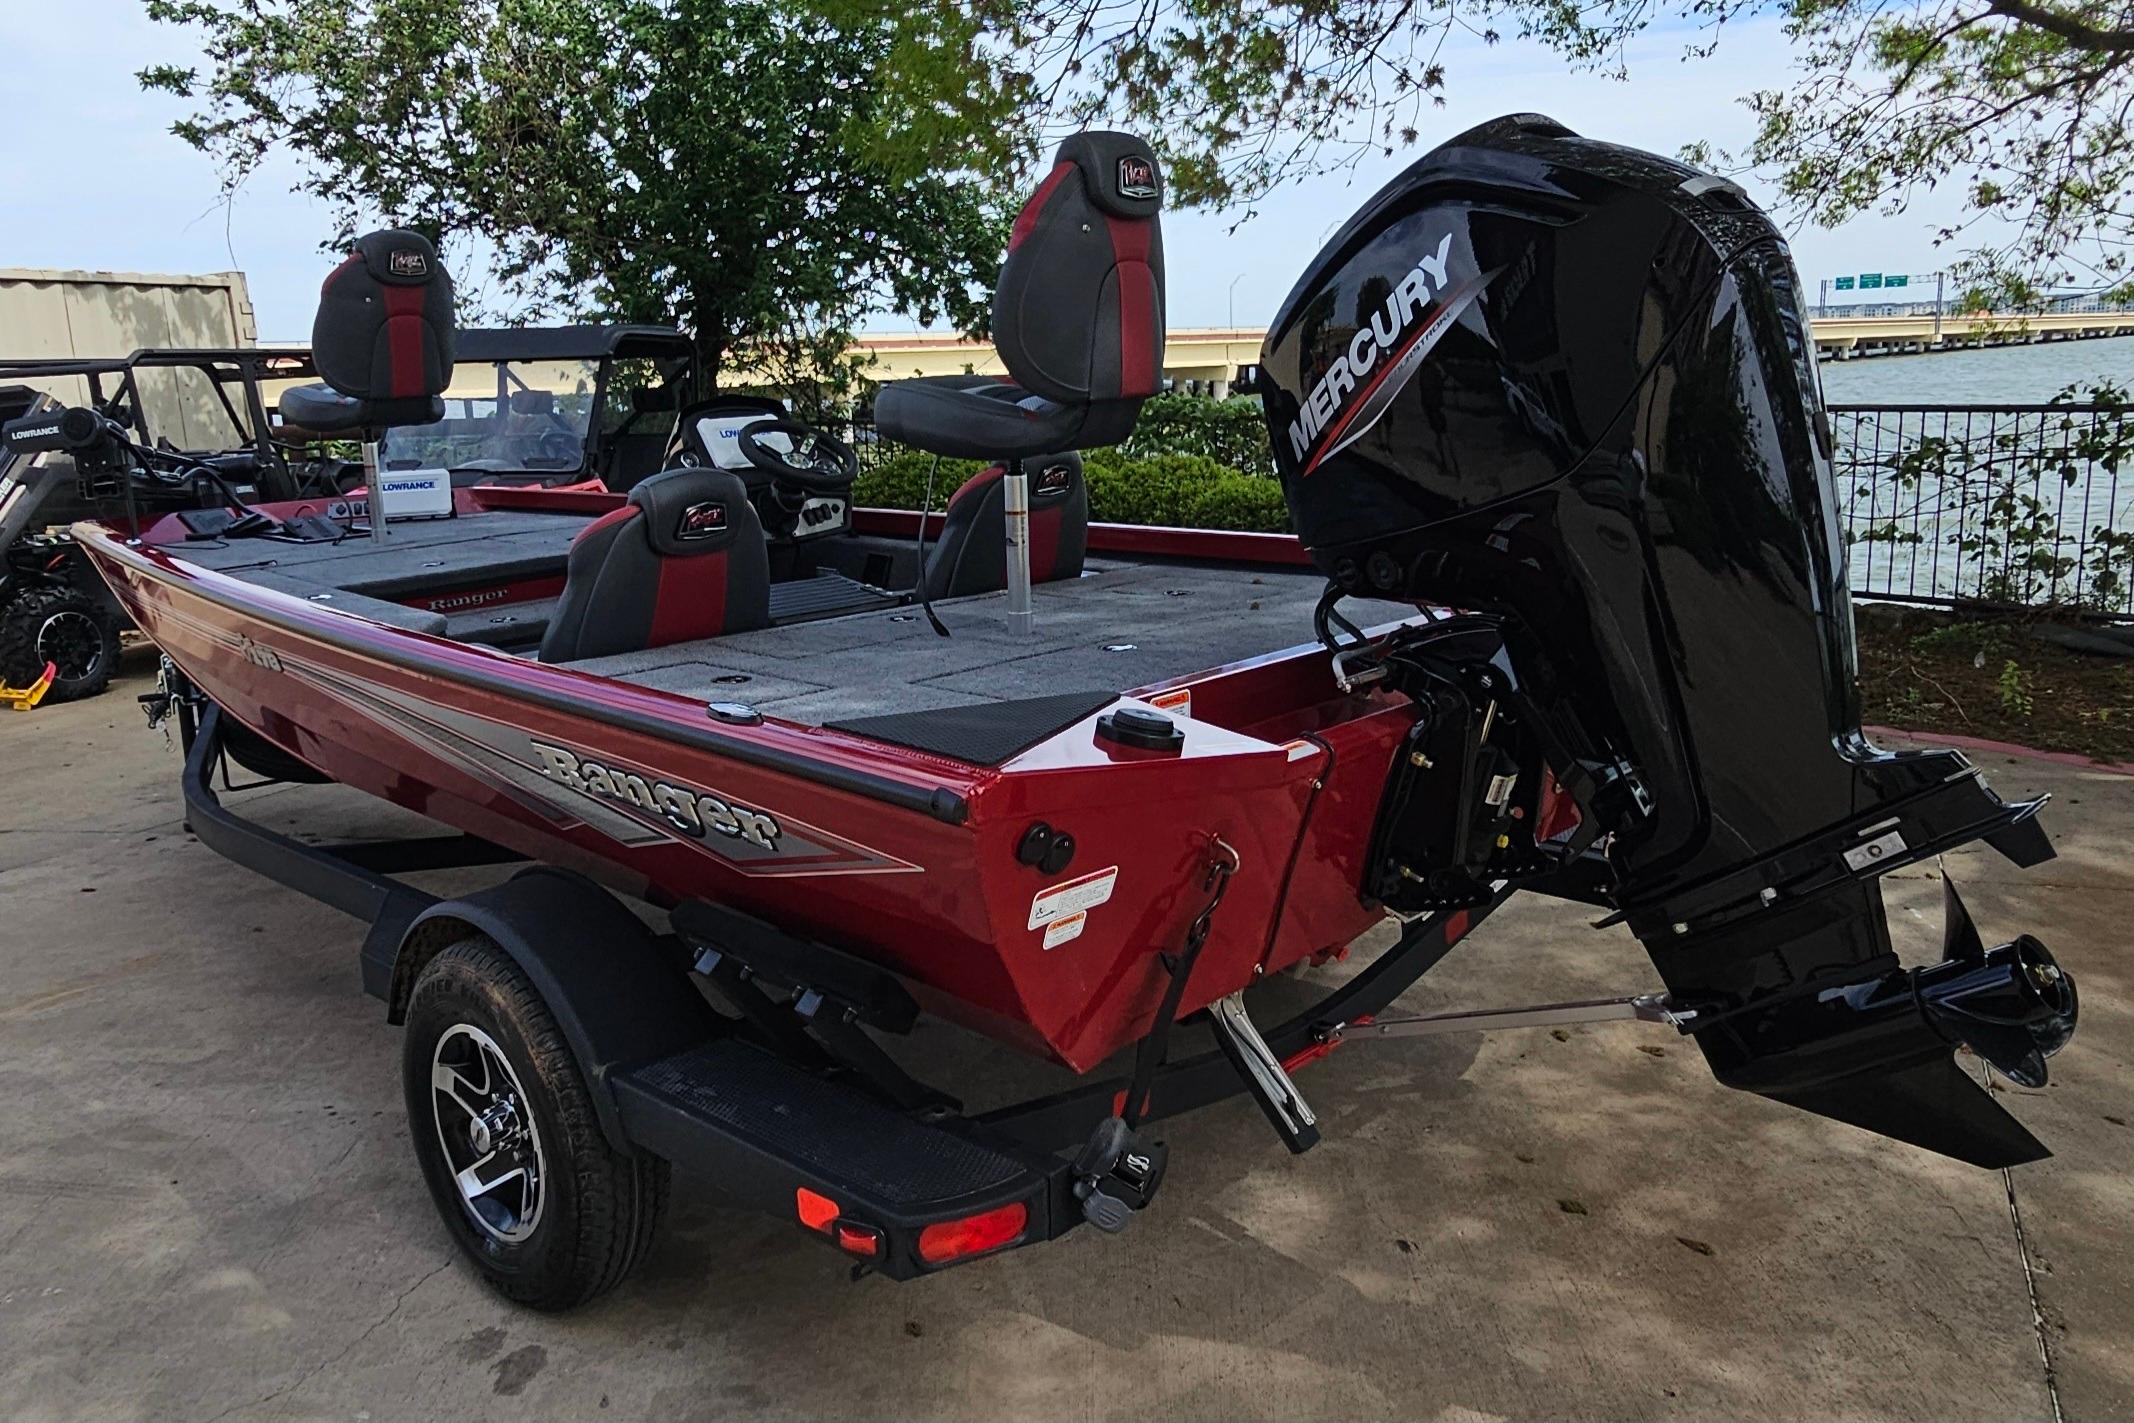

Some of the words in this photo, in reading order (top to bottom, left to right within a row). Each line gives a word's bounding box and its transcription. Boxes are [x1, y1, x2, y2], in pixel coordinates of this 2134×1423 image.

[1288, 233, 1452, 462] MERCURY
[11, 426, 60, 440] LOWRANCE
[382, 481, 435, 491] LOWRANCE
[427, 589, 508, 610] Ranger
[530, 738, 782, 851] Ranger
